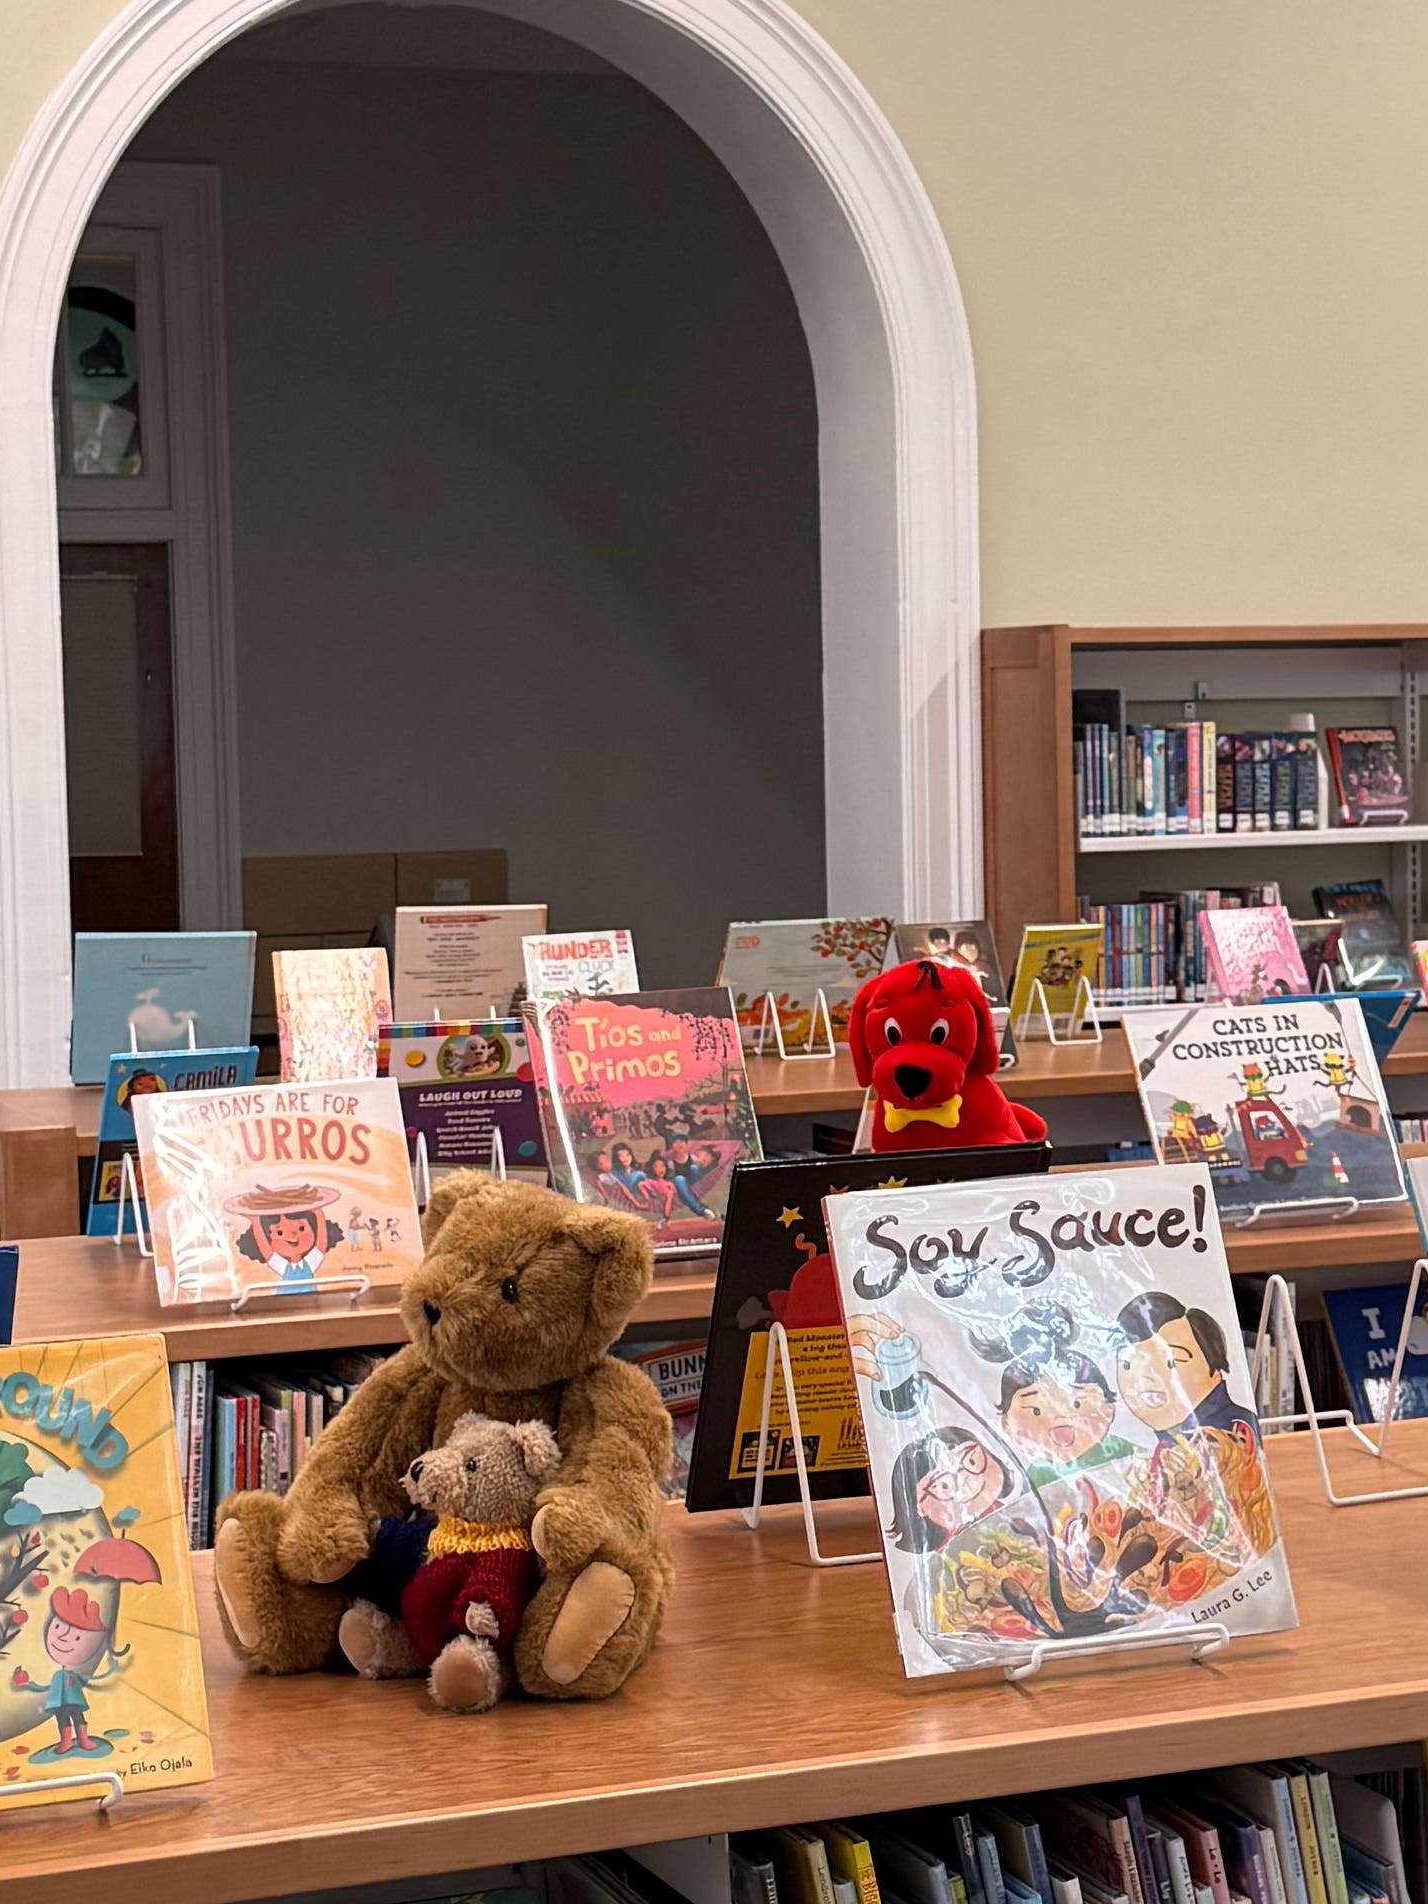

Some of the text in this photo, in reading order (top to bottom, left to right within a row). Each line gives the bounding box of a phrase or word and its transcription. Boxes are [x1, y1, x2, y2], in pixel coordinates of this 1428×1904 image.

[575, 1016, 682, 1052] Tíos and
[1212, 1013, 1300, 1037] CATS IN
[1172, 1032, 1344, 1061] CONSTRUCTION
[566, 1050, 682, 1085] Primos
[1265, 1054, 1323, 1077] HATS
[186, 1092, 360, 1126] FRIDAYS ARE FOR
[419, 1088, 523, 1102] LAUGH OUT LOUD
[853, 1184, 1208, 1300] Soy Sauce!
[1361, 1307, 1386, 1339] I
[1190, 1568, 1275, 1624] Laura G. Lee
[130, 1757, 192, 1777] Eiko Ojala
